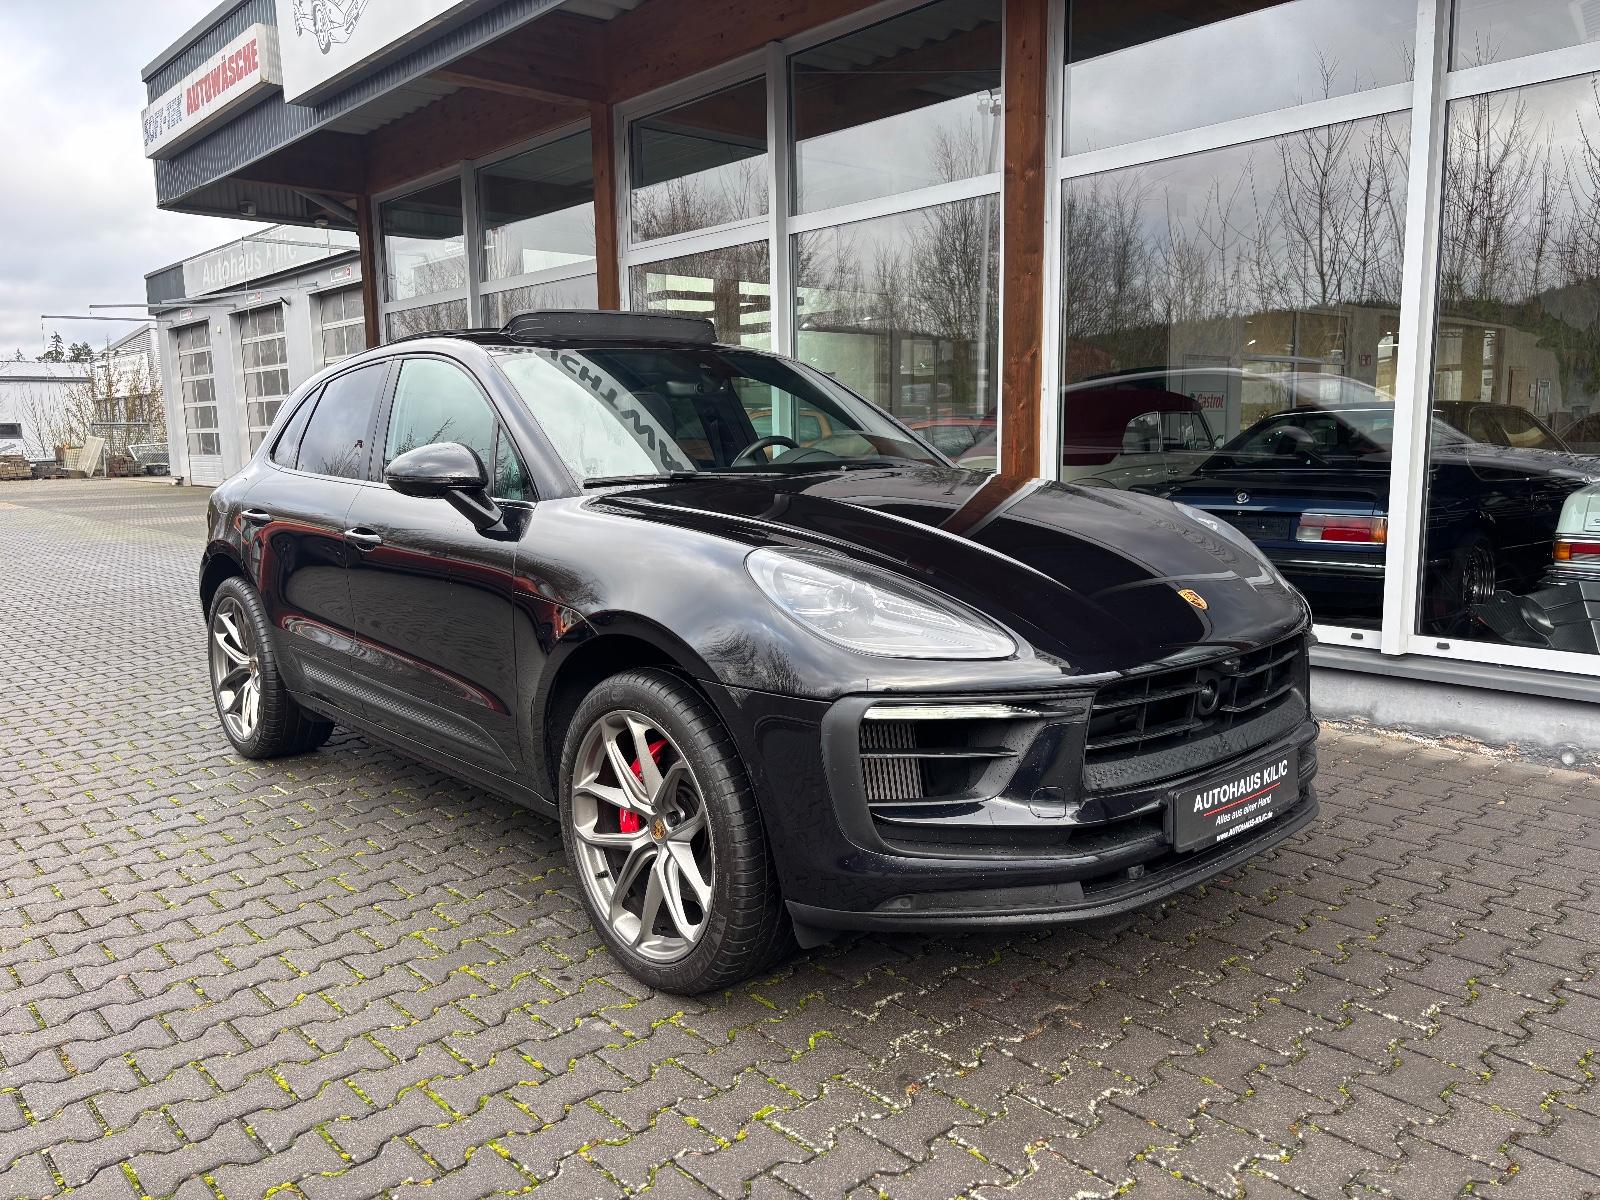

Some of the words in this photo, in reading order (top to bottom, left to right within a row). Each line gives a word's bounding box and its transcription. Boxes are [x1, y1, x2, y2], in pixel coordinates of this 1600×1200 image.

[186, 38, 259, 116] AUTOWÄSCHE
[202, 248, 262, 287] Autohaus
[1198, 394, 1224, 409] Castrol
[1193, 772, 1261, 812] AUTOHAUS
[1263, 760, 1288, 785] KILIC
[1215, 813, 1231, 826] Alles
[1231, 809, 1243, 820] aus
[1243, 801, 1258, 815] einer
[1258, 793, 1272, 809] Hand
